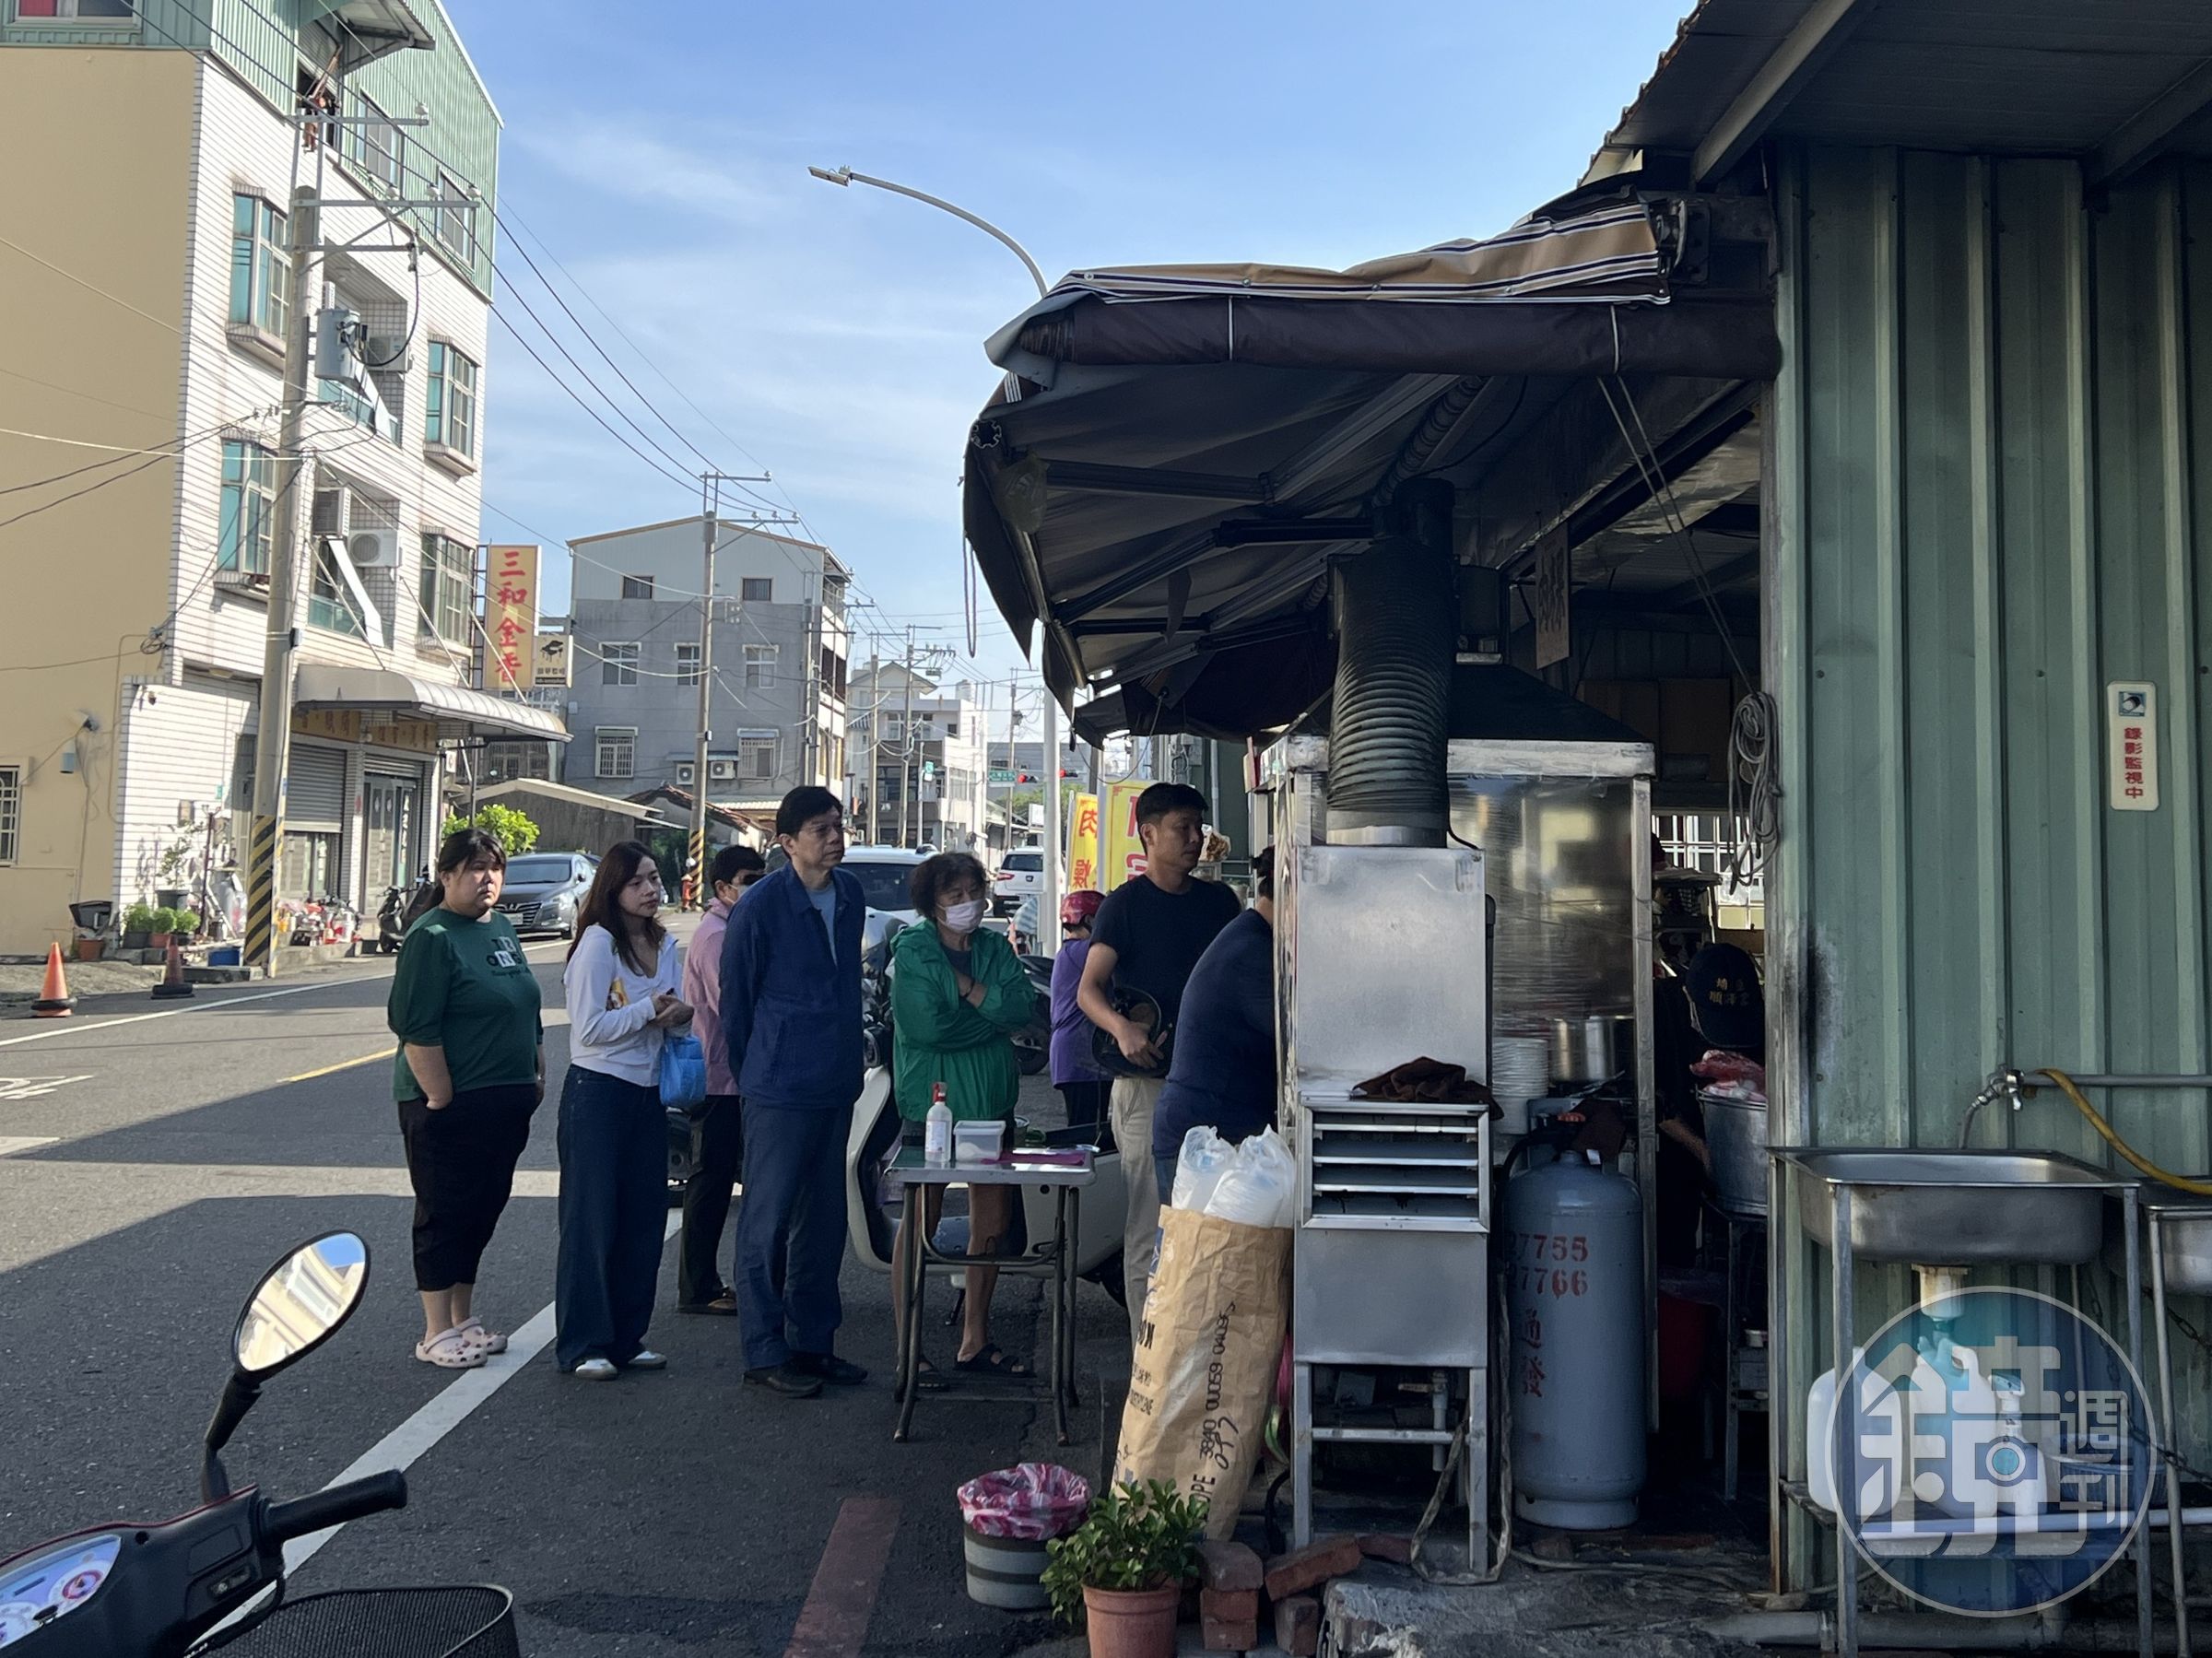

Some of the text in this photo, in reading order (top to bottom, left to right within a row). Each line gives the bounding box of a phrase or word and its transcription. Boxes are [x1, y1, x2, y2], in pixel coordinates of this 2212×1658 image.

[494, 551, 528, 682] 三和金香
[2124, 726, 2144, 799] 錄影監視中
